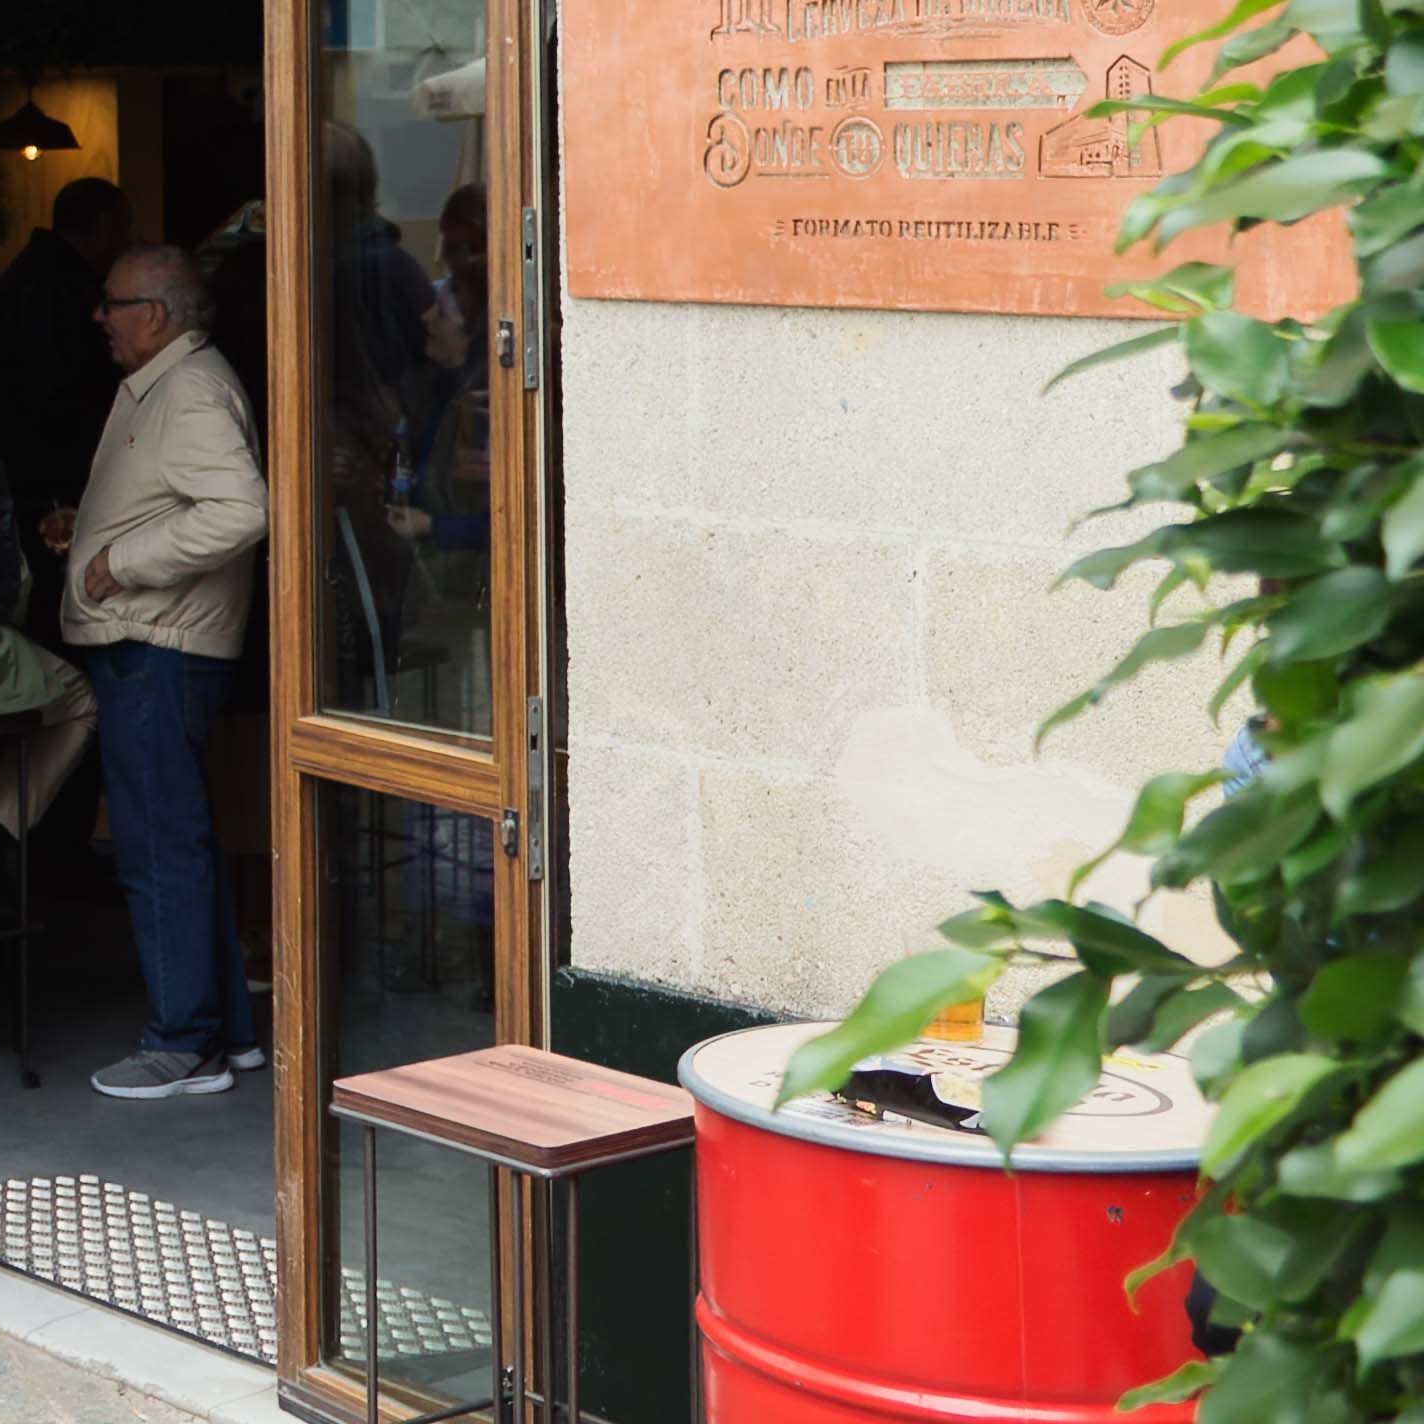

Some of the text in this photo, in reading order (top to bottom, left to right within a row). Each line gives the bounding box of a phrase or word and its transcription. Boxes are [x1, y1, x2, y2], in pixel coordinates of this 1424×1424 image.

[717, 67, 815, 111] COMO
[703, 112, 825, 189] DONDE
[893, 119, 1026, 177] QUIERAS
[791, 217, 1060, 242] FORMATO REUTILIZABLE
